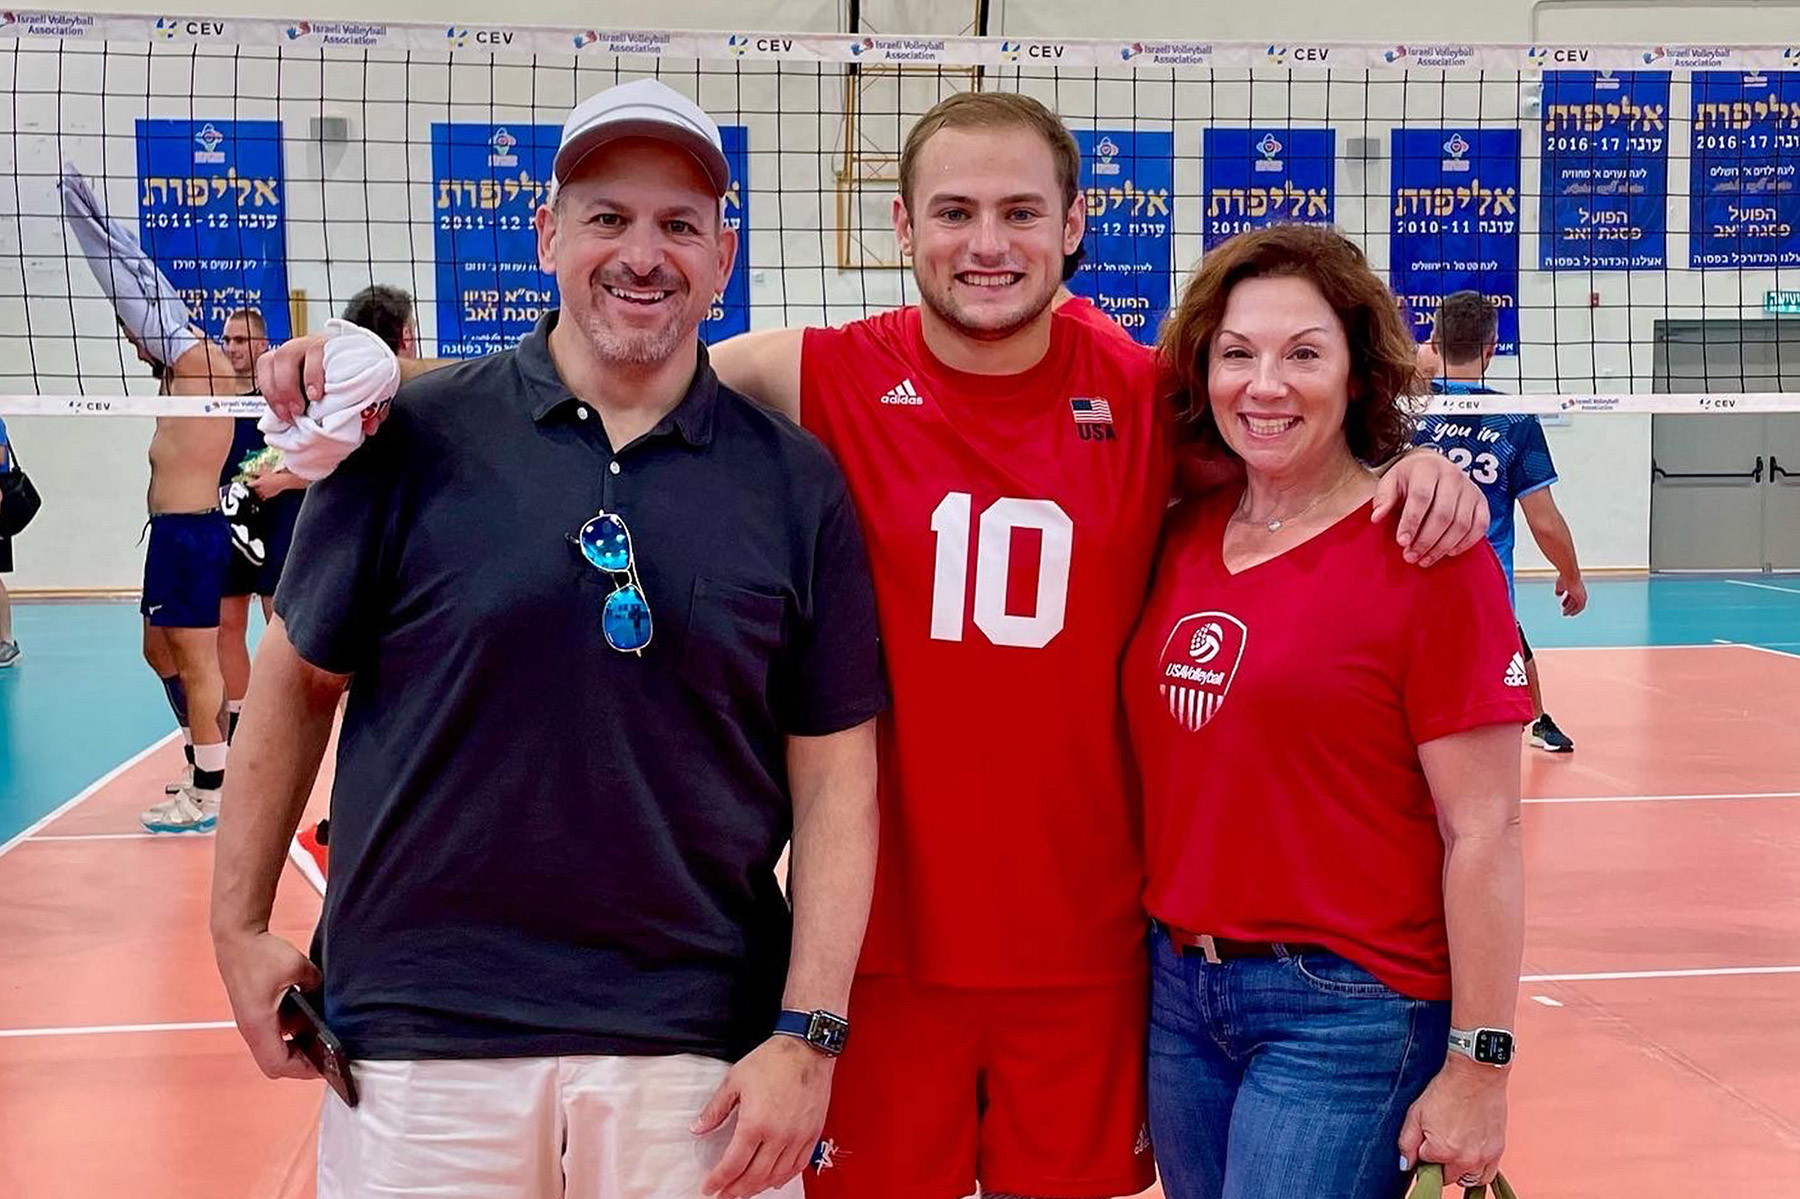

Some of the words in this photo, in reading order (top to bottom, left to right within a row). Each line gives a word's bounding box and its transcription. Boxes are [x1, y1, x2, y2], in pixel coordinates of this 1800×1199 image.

[17, 15, 46, 25] Israeli
[48, 16, 94, 27] Volleyball
[28, 26, 83, 36] Association
[186, 22, 224, 36] CEV
[313, 24, 341, 34] Israeli
[342, 25, 387, 36] Volleyball
[323, 35, 377, 46] Association
[476, 31, 514, 44] CEV
[599, 33, 626, 42] Israeli
[627, 34, 670, 45] Volleyball
[609, 44, 661, 53] Association
[757, 39, 793, 52] CEV
[875, 40, 902, 49] Israeli
[903, 41, 945, 51] Volleyball
[1029, 46, 1064, 58] CEV
[1144, 45, 1171, 54] Israeli
[1172, 45, 1213, 56] Volleyball
[885, 51, 936, 60] Association
[1294, 48, 1329, 61] CEV
[1408, 47, 1434, 56] Israeli
[1435, 47, 1475, 58] Volleyball
[1554, 49, 1589, 62] CEV
[1666, 49, 1690, 58] Israeli
[1691, 49, 1731, 60] Volleyball
[1153, 55, 1203, 64] Association
[1417, 57, 1466, 66] Association
[1674, 58, 1722, 67] Association
[1545, 95, 1664, 132] אליפות
[1547, 137, 1620, 151] 2016-17
[1697, 135, 1768, 150] 2016-17
[1774, 135, 1800, 149] ונת
[142, 167, 279, 207] אליפות
[437, 170, 551, 209] ליפות
[1084, 180, 1169, 217] אליפ
[1207, 180, 1328, 217] אליפות
[1395, 178, 1516, 217] אליפות
[1578, 207, 1628, 225] הפועל
[1728, 205, 1777, 222] הפועל
[1414, 311, 1437, 326] אב
[87, 402, 111, 411] CEV
[881, 394, 924, 406] adidas
[1458, 401, 1480, 410] CEV
[1715, 399, 1736, 408] CEV
[1077, 423, 1116, 442] USA
[1431, 421, 1473, 442] you
[1477, 426, 1501, 444] in
[930, 491, 1074, 649] 10
